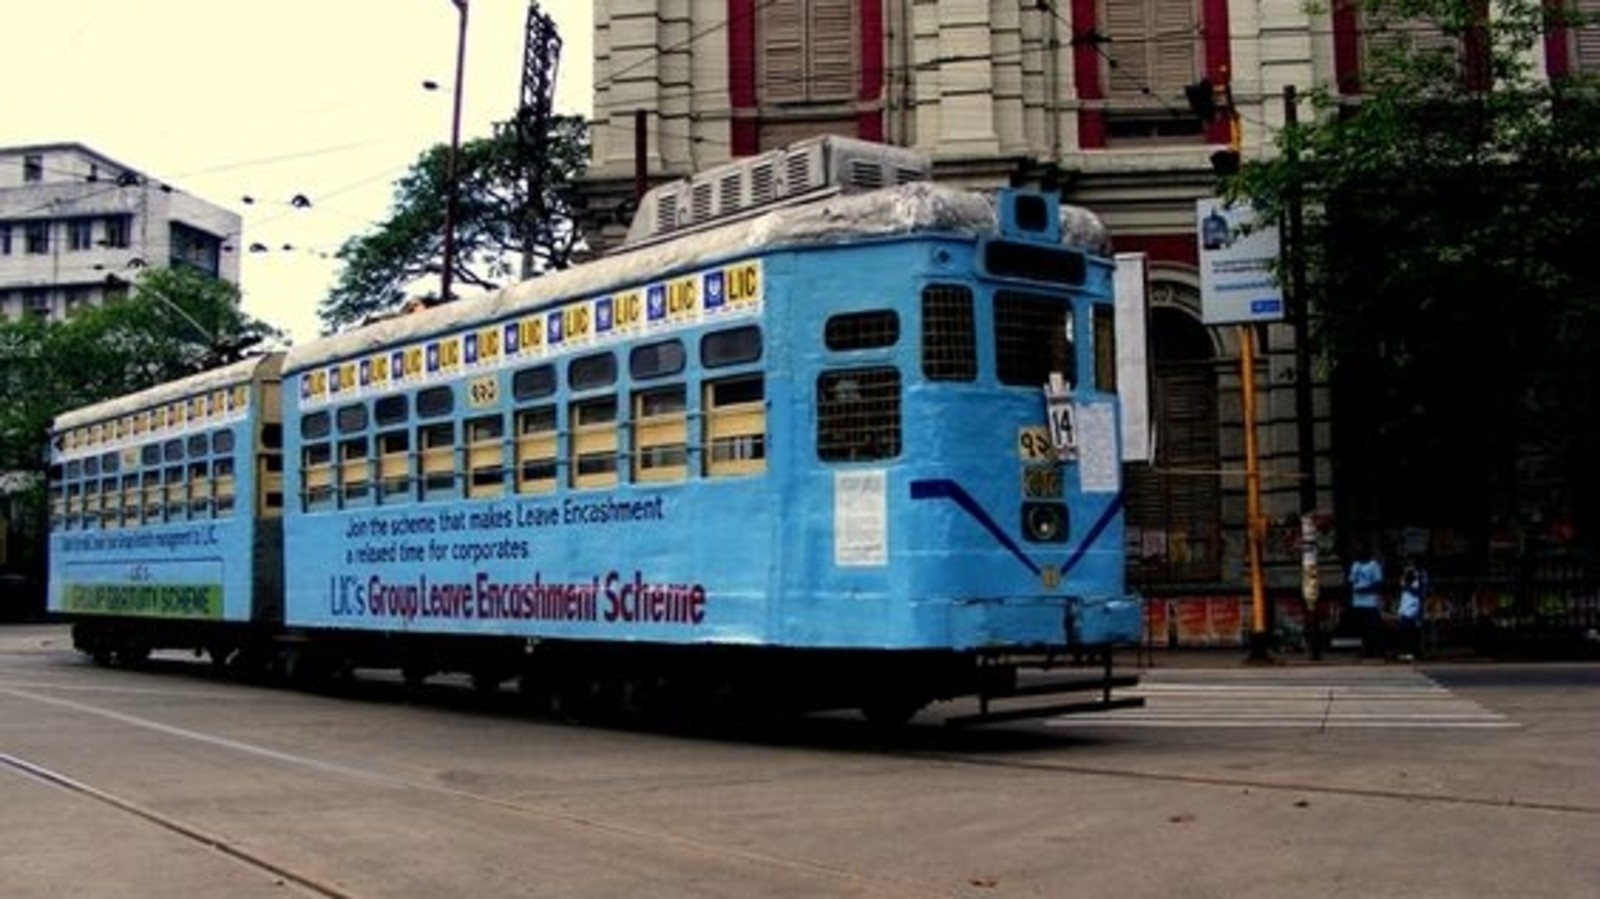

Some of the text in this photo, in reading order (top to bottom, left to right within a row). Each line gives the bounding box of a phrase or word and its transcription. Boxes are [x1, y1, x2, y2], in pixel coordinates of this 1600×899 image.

[522, 318, 541, 348] LIC
[566, 306, 588, 337] LIC
[615, 293, 640, 325] LIC
[669, 280, 696, 313] LIC
[728, 266, 756, 300] LIC
[1052, 410, 1074, 445] 14
[346, 496, 664, 538] Join the scheme that makes Leave Encashment
[346, 547, 353, 564] a
[357, 541, 396, 562] relaxed
[400, 542, 424, 562] time
[429, 538, 448, 560] for
[331, 570, 706, 624] LIC's Group Leave Encashment Scheme
